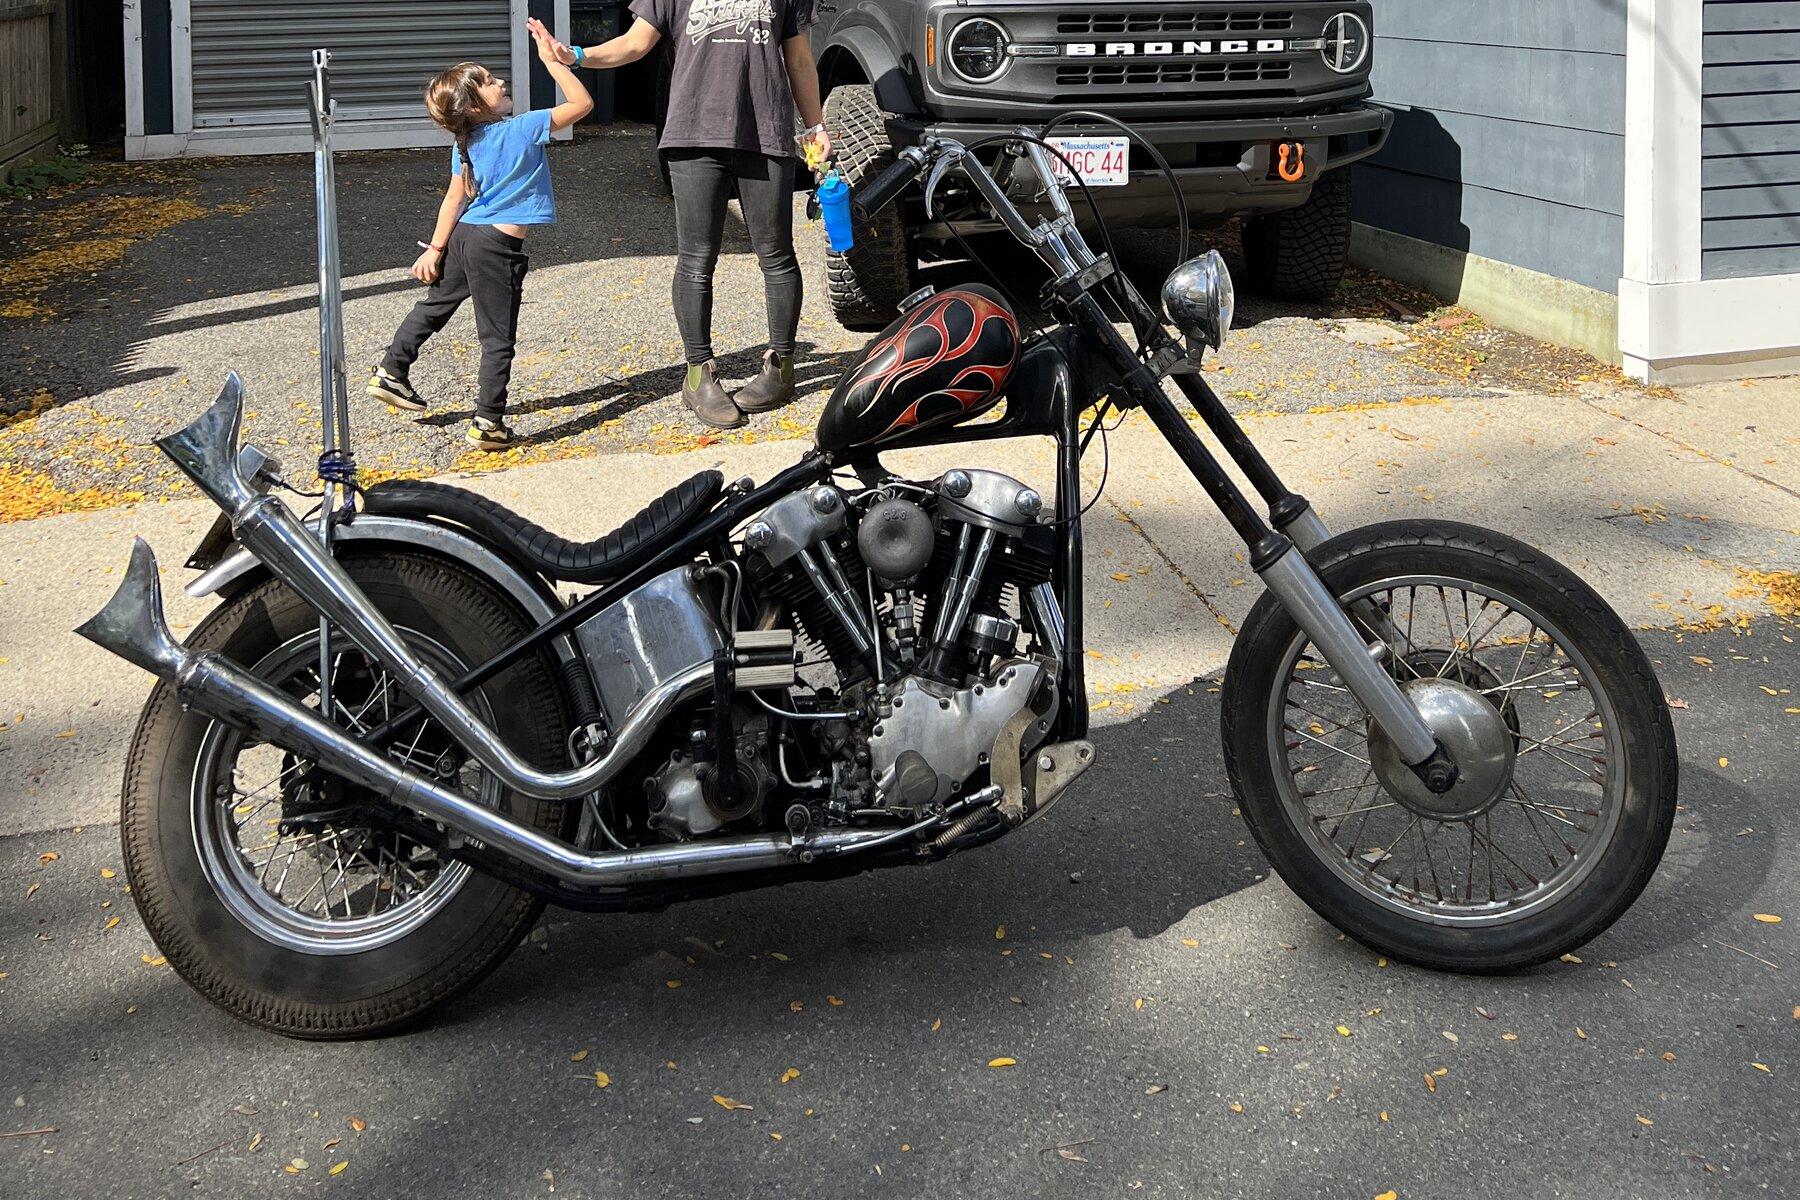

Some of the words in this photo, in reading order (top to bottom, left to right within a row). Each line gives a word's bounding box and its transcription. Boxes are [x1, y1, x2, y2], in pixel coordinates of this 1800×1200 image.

[1066, 40, 1284, 56] BRONCO
[1062, 141, 1110, 150] Massachusetts
[1101, 150, 1123, 173] 44
